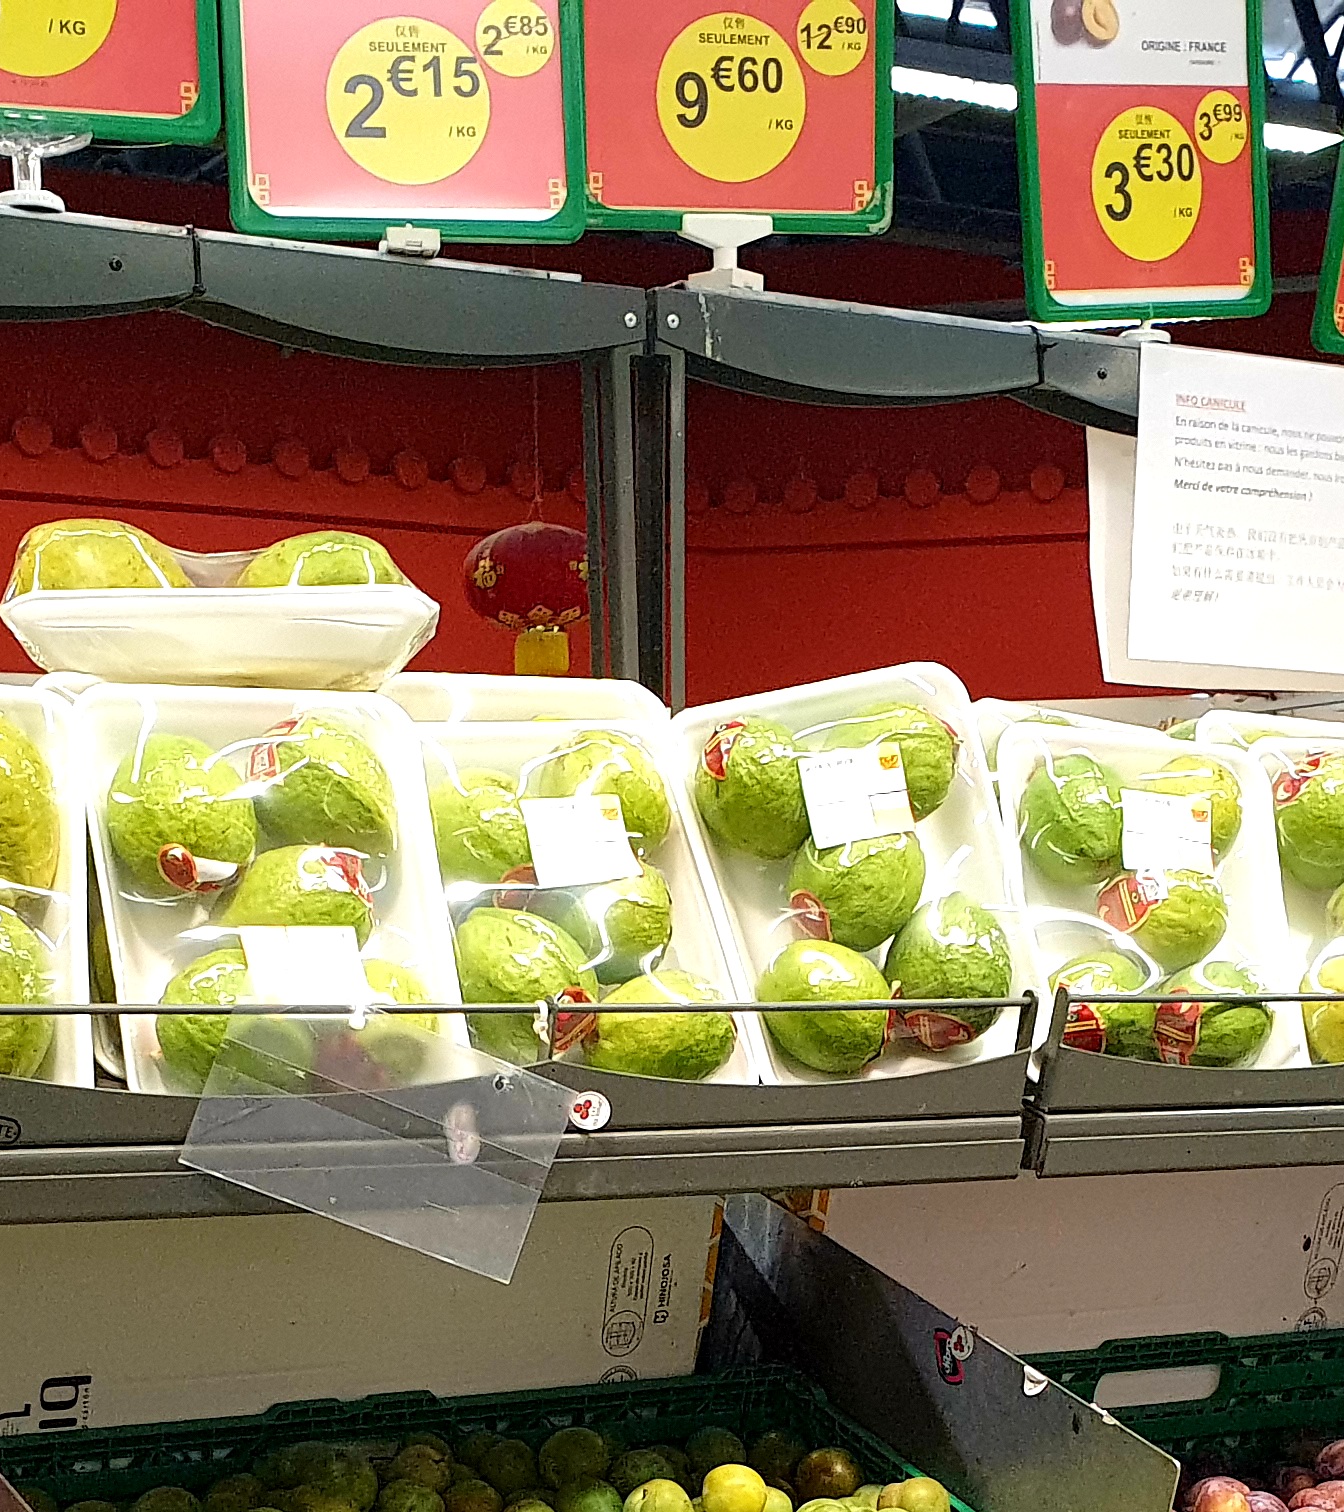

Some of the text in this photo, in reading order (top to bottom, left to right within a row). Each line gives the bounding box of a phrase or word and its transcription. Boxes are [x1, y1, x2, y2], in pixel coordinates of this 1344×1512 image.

[698, 33, 771, 46] SEULEMENT
[368, 41, 447, 54] SEULEMENT
[1140, 40, 1227, 53] ORIGINE FRANCE
[343, 55, 481, 139] 2€15
[675, 55, 783, 129] 9€60
[1118, 129, 1171, 140] SEULEMENT
[1104, 143, 1195, 222] 3€30
[1174, 479, 1200, 491] Merci
[1201, 482, 1213, 492] de
